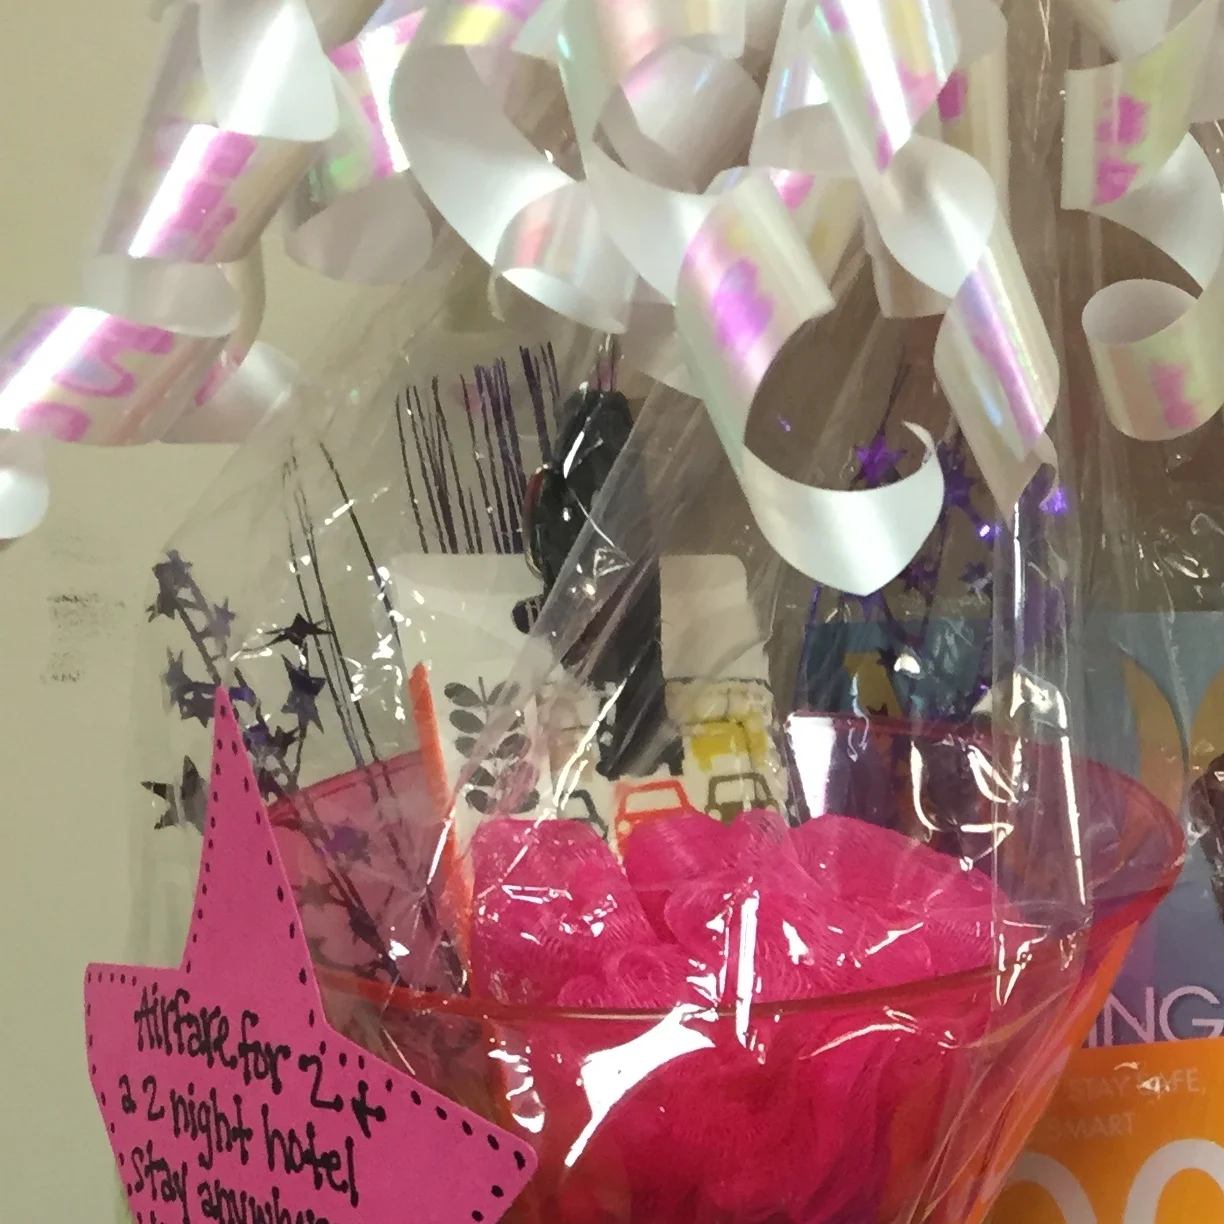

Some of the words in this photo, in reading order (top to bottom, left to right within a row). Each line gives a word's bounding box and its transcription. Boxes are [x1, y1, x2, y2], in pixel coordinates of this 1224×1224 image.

[134, 982, 238, 1070] Airfare
[238, 1010, 291, 1095] for
[298, 1054, 344, 1112] 2
[119, 1074, 137, 1114] a
[142, 1075, 165, 1121] 2
[170, 1082, 253, 1170] night
[261, 1103, 359, 1208] hotel
